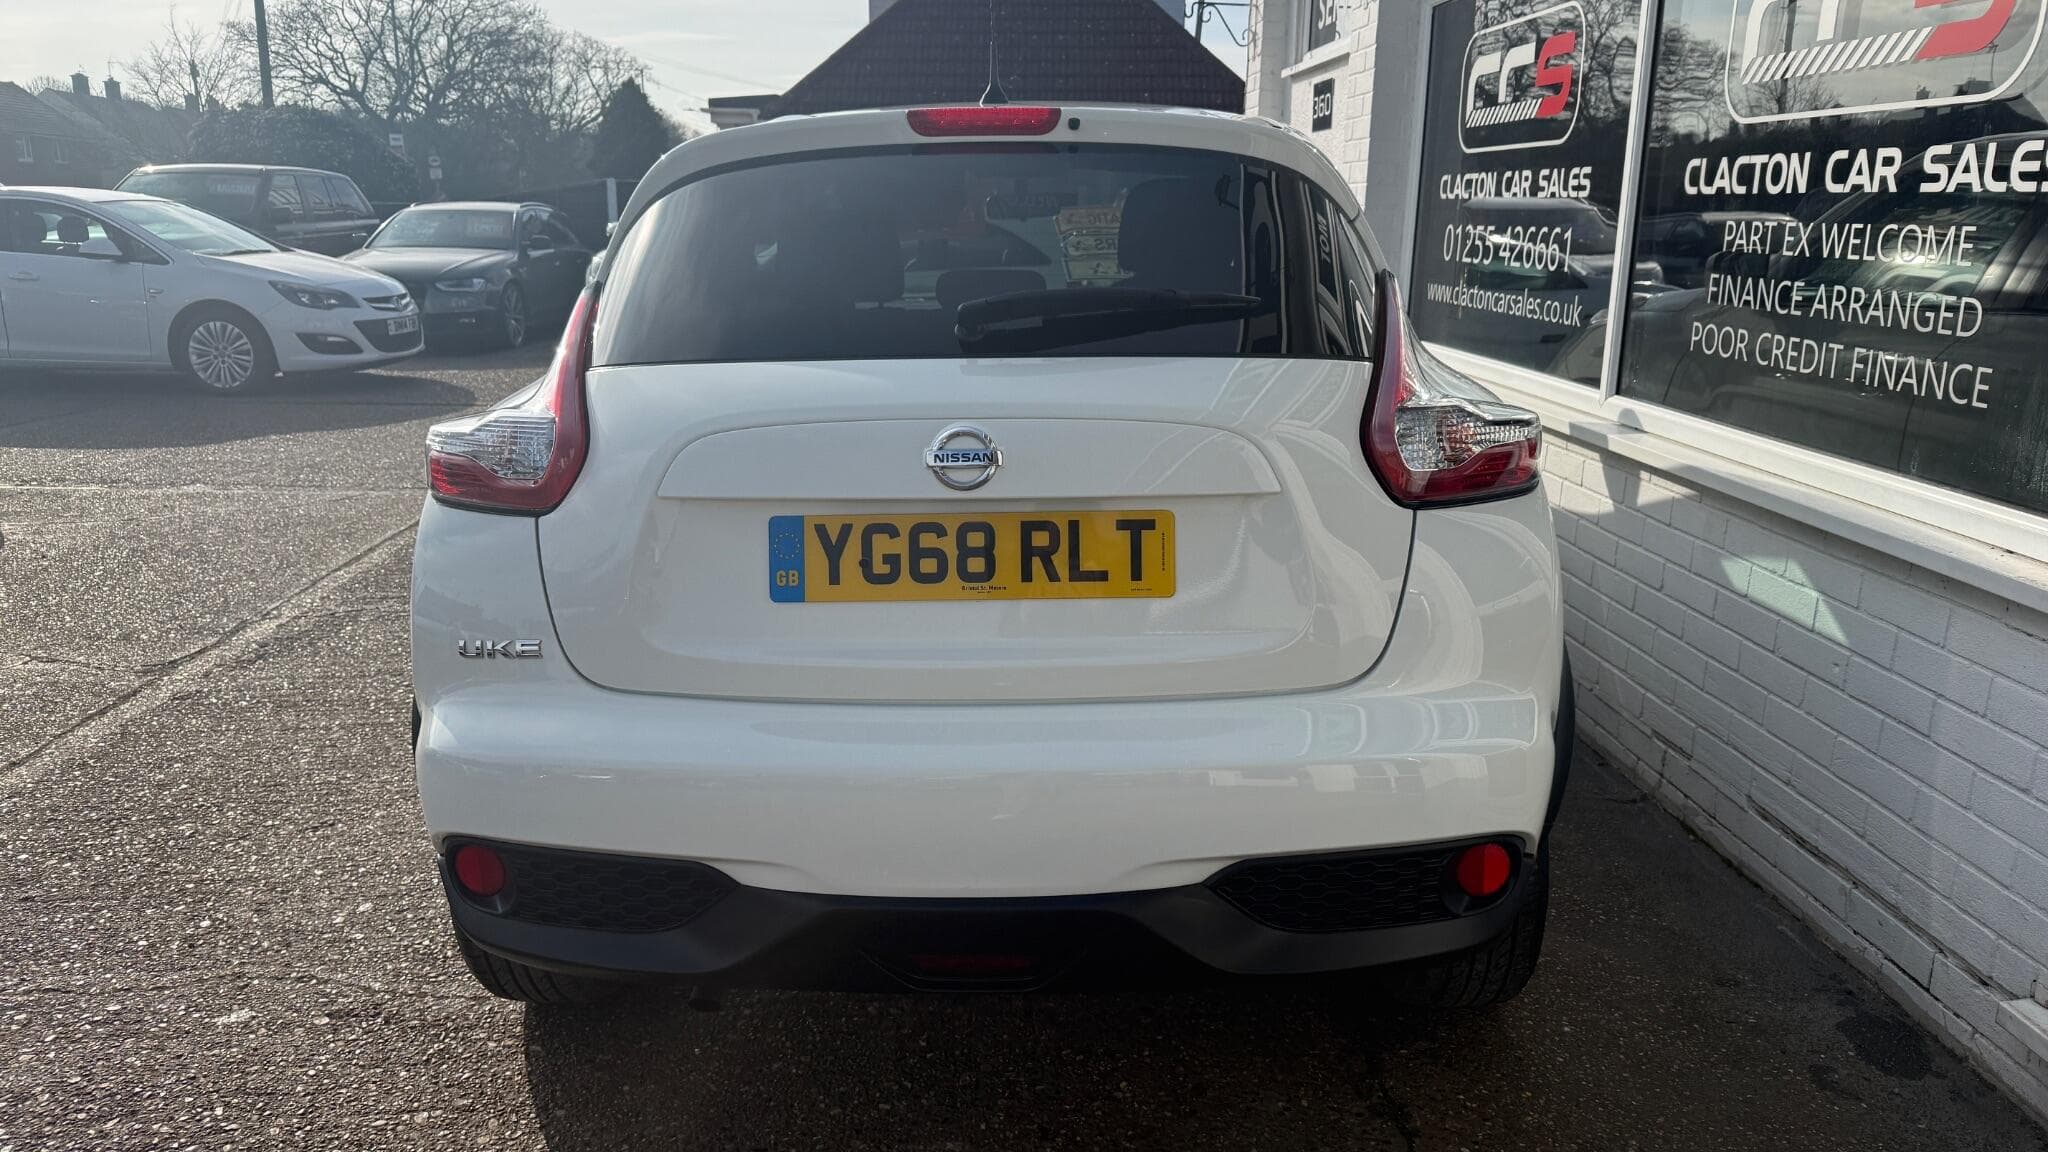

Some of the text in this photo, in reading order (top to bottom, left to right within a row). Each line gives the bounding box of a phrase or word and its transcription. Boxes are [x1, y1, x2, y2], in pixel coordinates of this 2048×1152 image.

[1312, 93, 1332, 119] 360
[1439, 166, 1592, 200] CLACTON CAR SALES
[1684, 139, 2048, 195] CLACTON CAR SALE
[1443, 224, 1573, 273] 01255 426661
[1722, 220, 1978, 267] PART EX WELCOME
[1427, 280, 1583, 328] www.clactoncarsales.co.uk
[1706, 273, 1983, 338] FINANCE ARRANGED
[1690, 321, 1993, 409] POOR CREDIT FINANCE
[933, 452, 994, 464] NISSAN
[814, 521, 996, 586] YG68
[1020, 519, 1156, 583] RLT
[776, 570, 799, 587] GB
